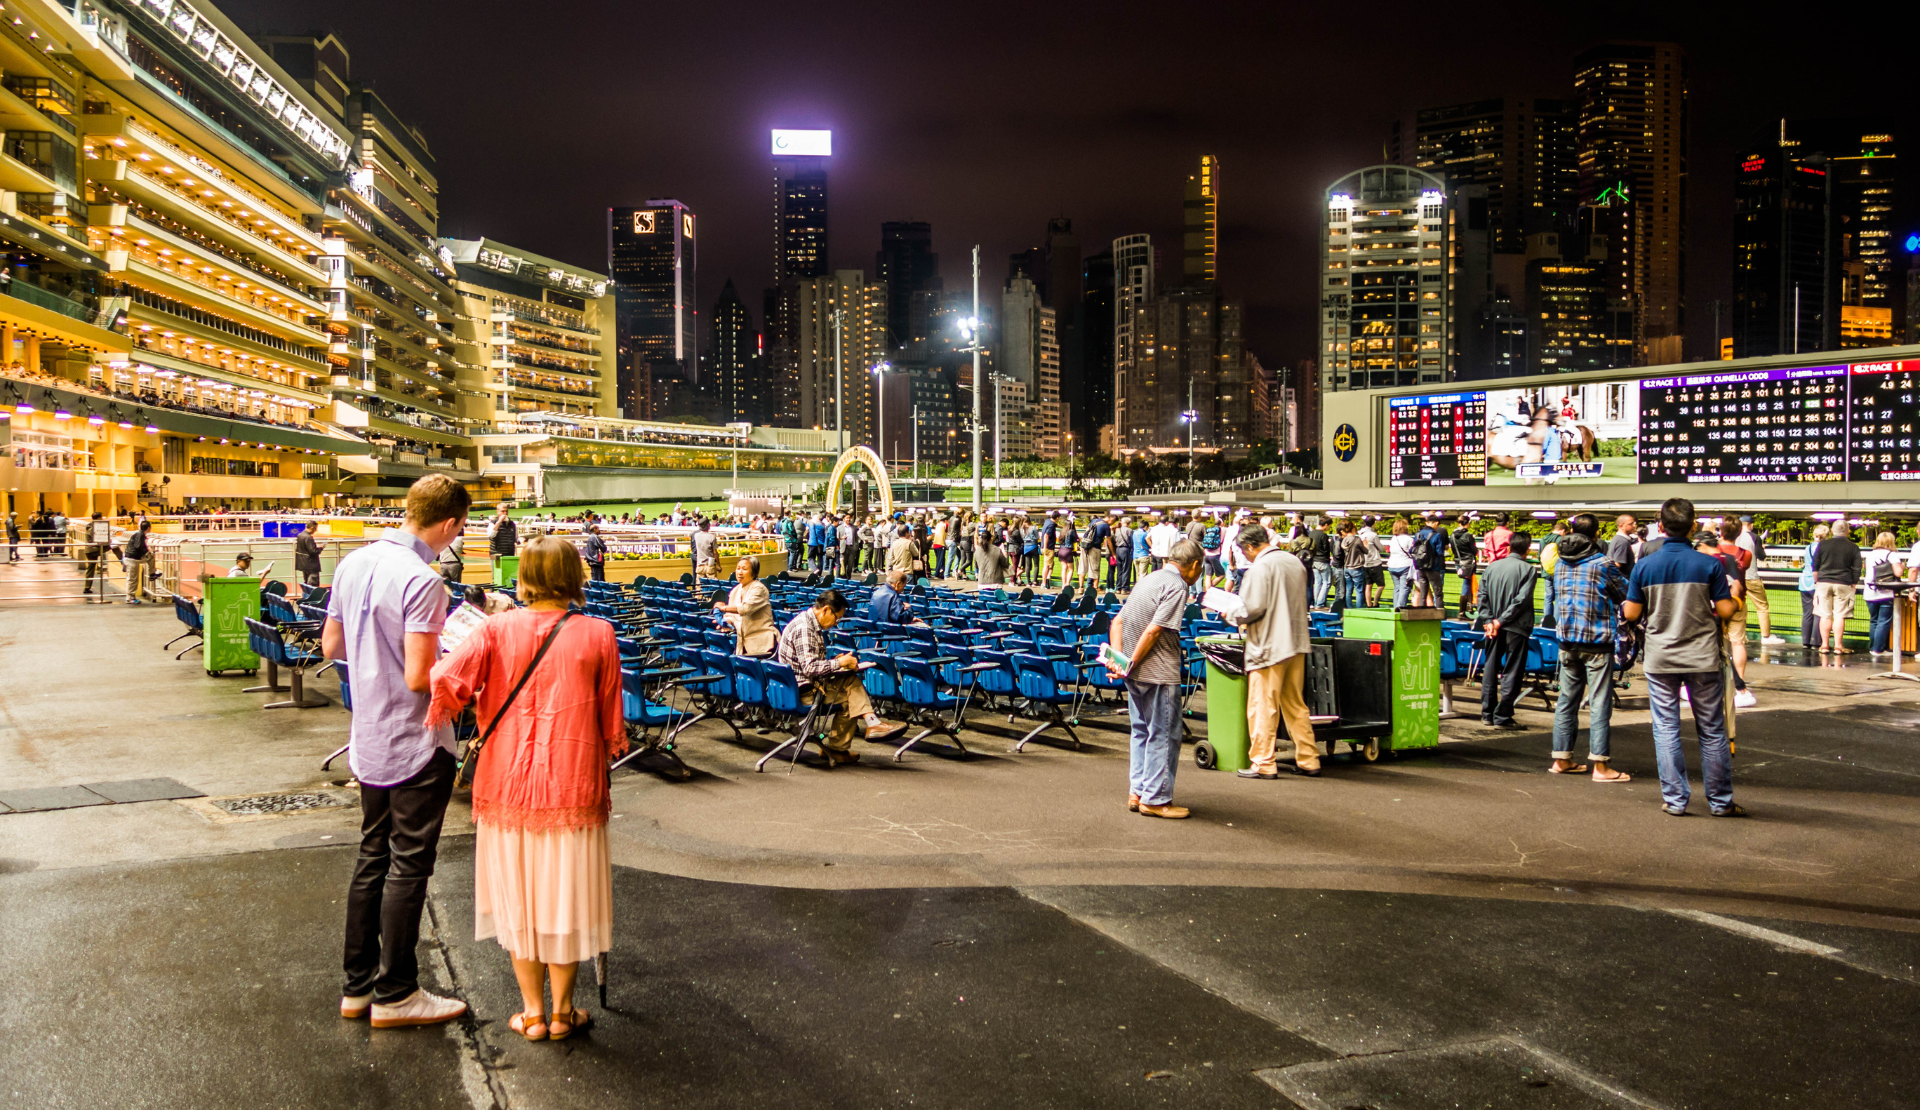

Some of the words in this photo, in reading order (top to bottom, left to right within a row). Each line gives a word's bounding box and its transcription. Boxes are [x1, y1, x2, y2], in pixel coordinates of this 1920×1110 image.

[1870, 363, 1892, 372] RACE
[1896, 361, 1902, 371] 1
[1656, 379, 1674, 387] RACE
[1677, 377, 1682, 386] 1
[1714, 373, 1748, 383] QUINELLA
[1748, 372, 1769, 380] ODDS
[1786, 370, 1790, 378] 1
[1880, 381, 1895, 389] 4.9
[1901, 380, 1912, 389] 24
[1695, 393, 1704, 401] 97
[1710, 392, 1719, 400] 35
[1723, 391, 1736, 399] 271
[1741, 390, 1751, 398] 20
[1756, 389, 1769, 397] 101
[1774, 388, 1783, 396] 61
[1805, 385, 1820, 394] 234
[1825, 384, 1836, 393] 27
[1863, 396, 1874, 405] 24
[1901, 394, 1912, 403] 13
[1694, 406, 1703, 414] 61
[1757, 402, 1767, 411] 55
[1774, 402, 1784, 410] 25
[1791, 401, 1800, 409] 17
[1825, 399, 1836, 407] 10
[1693, 419, 1705, 427] 192
[1741, 417, 1751, 425] 69
[1772, 415, 1786, 423] 115
[1790, 415, 1800, 423] 84
[1825, 413, 1835, 421] 75
[1864, 411, 1873, 419] 11
[1881, 410, 1892, 419] 27
[1708, 432, 1721, 440] 135
[1741, 431, 1750, 439] 80
[1772, 429, 1785, 437] 150
[1789, 428, 1802, 437] 122
[1805, 428, 1819, 436] 393
[1823, 427, 1837, 435] 104
[1862, 425, 1875, 434] 8.7
[1881, 425, 1892, 434] 20
[1901, 424, 1911, 432] 14
[1662, 446, 1675, 454] 407
[1692, 446, 1705, 454] 220
[1741, 444, 1750, 452] 35
[1756, 443, 1767, 452] 85
[1773, 443, 1783, 451] 70
[1789, 442, 1800, 450] 47
[1805, 442, 1819, 450] 304
[1824, 441, 1835, 450] 40
[1862, 440, 1874, 449] 39
[1879, 439, 1894, 448] 114
[1900, 439, 1911, 447] 62
[1693, 459, 1703, 467] 20
[1707, 458, 1721, 466] 129
[1738, 457, 1752, 466] 249
[1771, 457, 1785, 465] 275
[1787, 456, 1802, 465] 293
[1821, 455, 1837, 464] 210
[1861, 454, 1875, 463] 7.3
[1880, 454, 1892, 463] 23
[1900, 453, 1910, 462] 11
